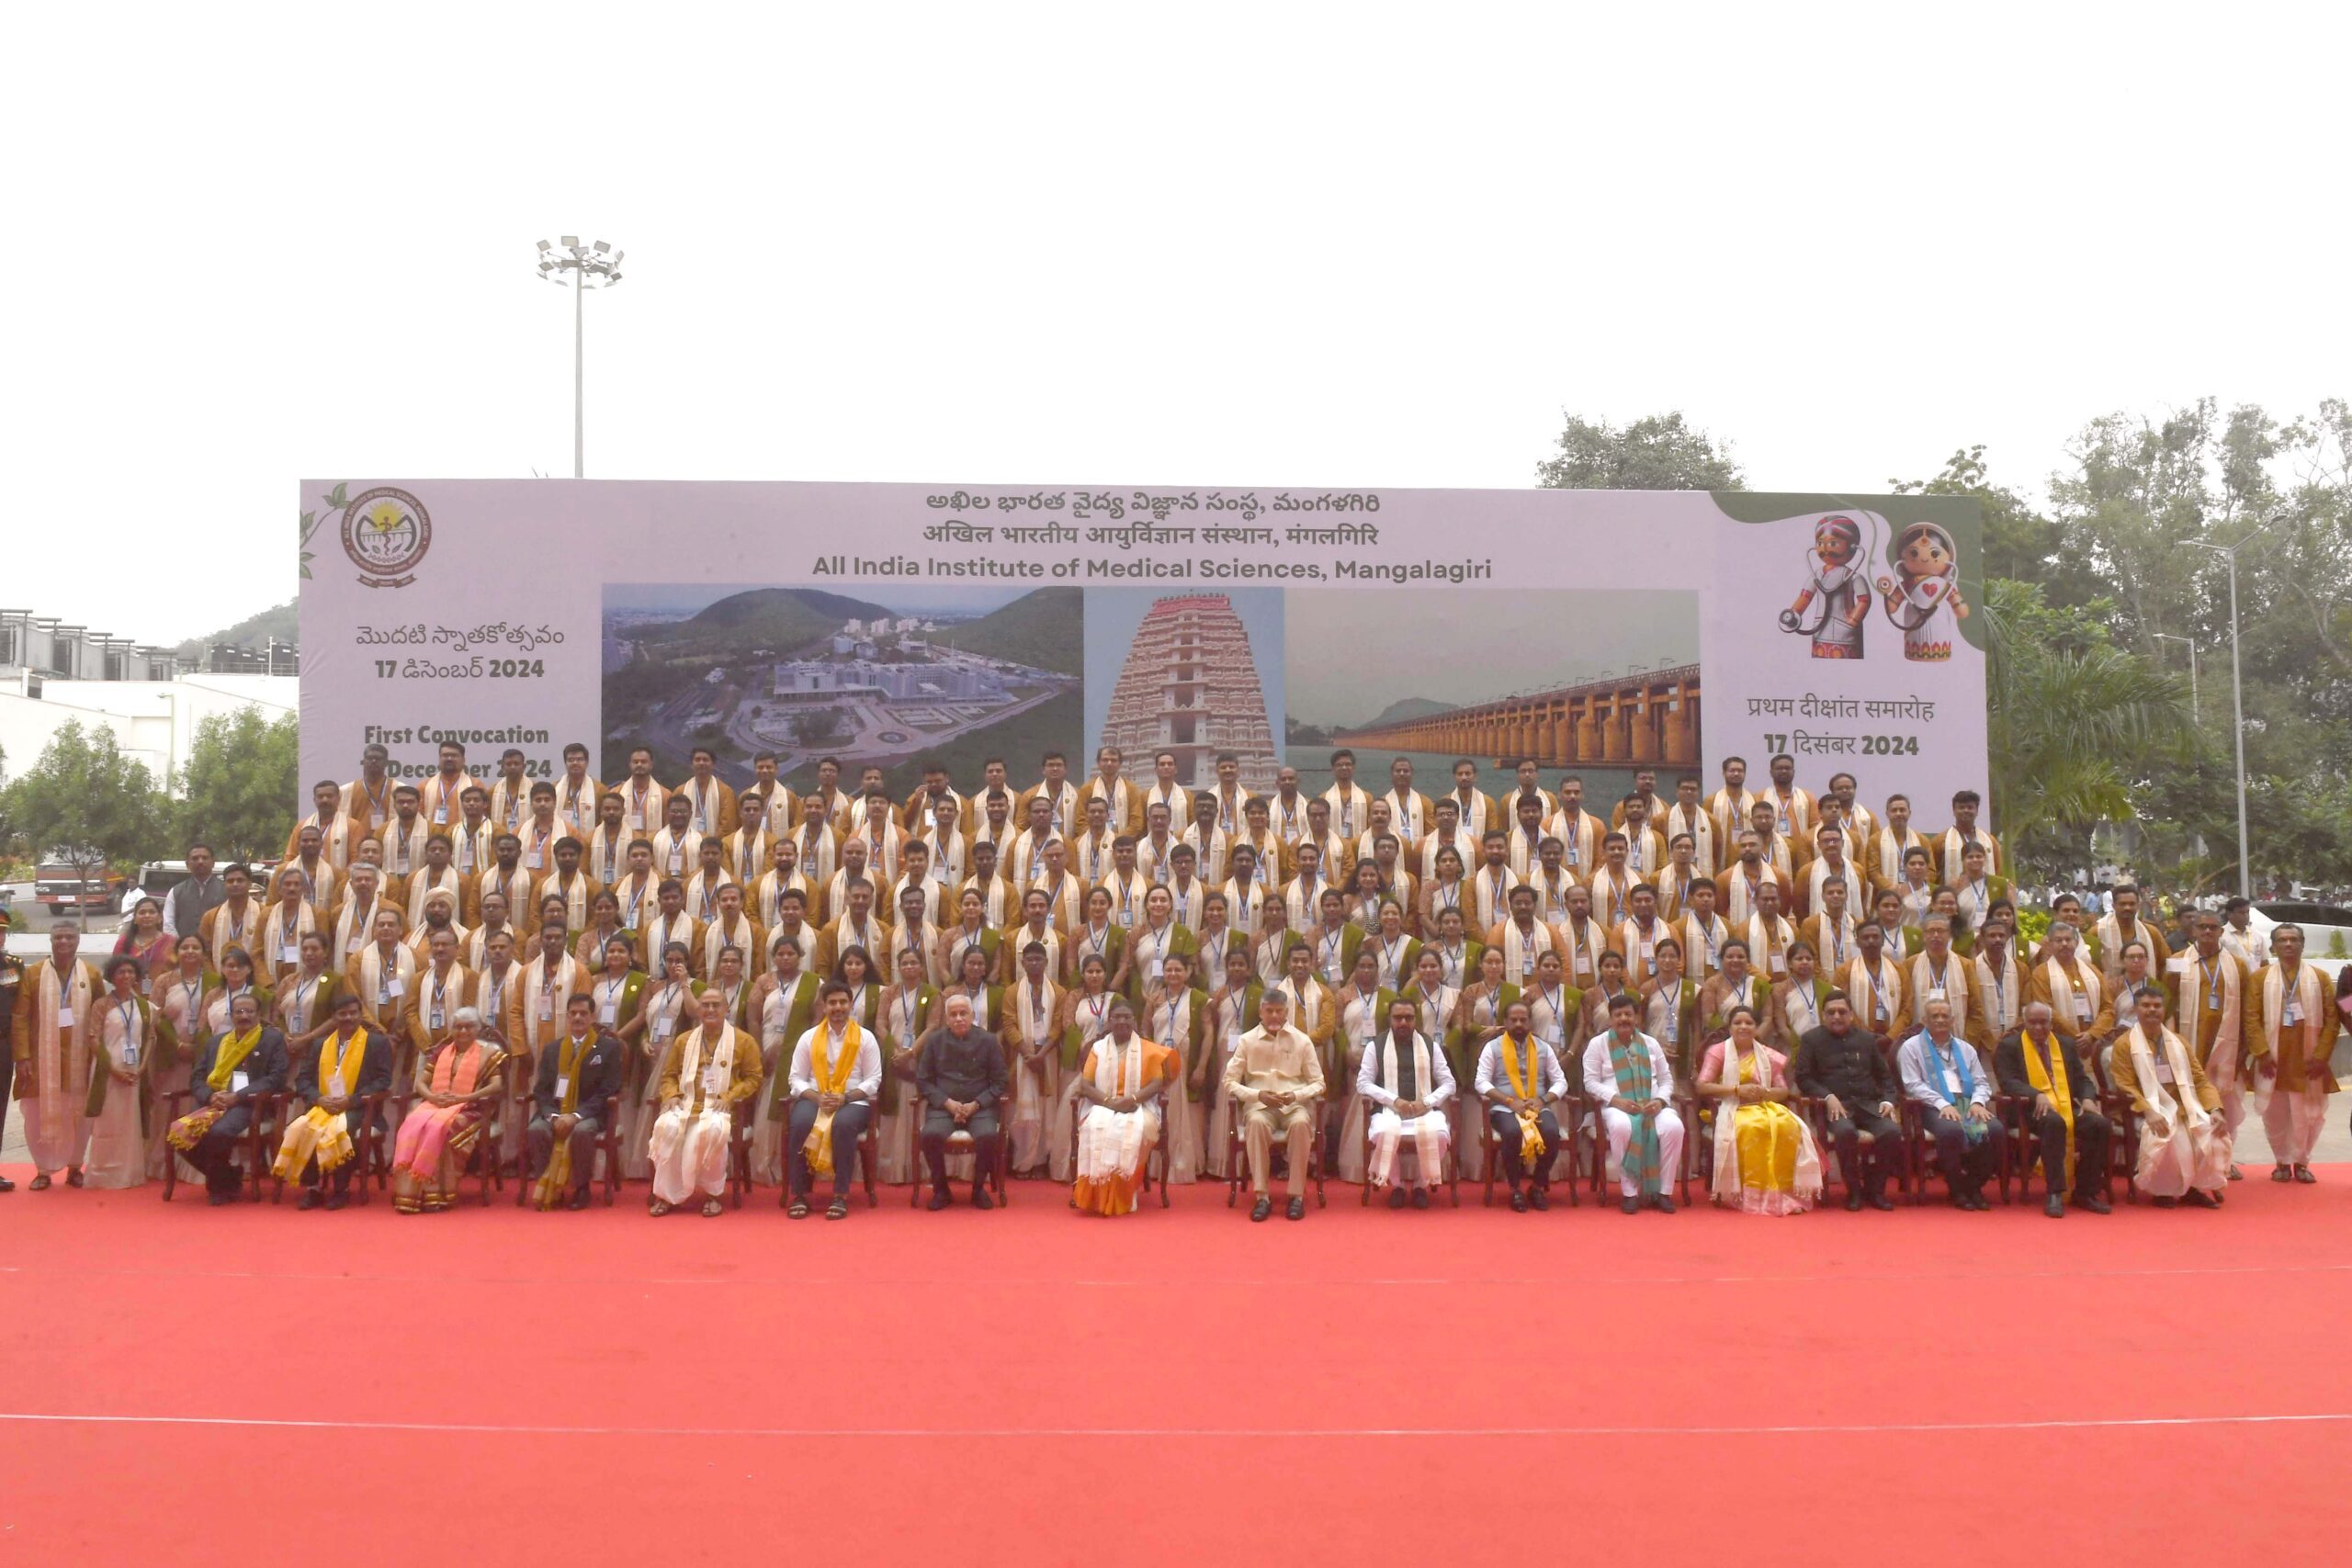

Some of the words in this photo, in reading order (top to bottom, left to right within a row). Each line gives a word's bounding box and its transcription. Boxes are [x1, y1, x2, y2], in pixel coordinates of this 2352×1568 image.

[926, 491, 990, 512] అఖిల
[998, 492, 1066, 513] భారత
[1073, 491, 1125, 519] వైద్య
[1131, 491, 1199, 521] విజ్ఞాన
[1206, 491, 1266, 522] సంస్థ,
[1273, 492, 1381, 513] మంగళగిరి
[923, 520, 995, 543] अखिल
[1001, 521, 1080, 544] भारतीय
[1086, 521, 1196, 550] आयुर्विज्ञान
[1201, 523, 1280, 547] संस्थान,
[1285, 523, 1380, 546] मंगलगिरि
[812, 555, 846, 575] All
[854, 556, 920, 576] India
[928, 556, 1045, 578] Institute
[1051, 558, 1080, 578] of
[1087, 557, 1193, 579] Medical
[1199, 558, 1328, 581] Sciences,
[1335, 558, 1491, 584] Mangalagiri
[356, 624, 427, 645] మొదటి
[432, 621, 565, 652] స్నాతకోత్సవం
[375, 660, 398, 678] 17
[402, 656, 484, 679] డిసెంబర్
[489, 659, 545, 678] 2024
[1747, 698, 1795, 716] प्रथम
[1799, 693, 1860, 718] दीक्षांत
[1864, 694, 1936, 722] समारोह
[364, 725, 413, 744] First
[417, 724, 549, 744] Convocation
[1763, 733, 1788, 754] 17
[1792, 729, 1857, 755] दिसंबर
[1861, 735, 1920, 756] 2024
[387, 760, 492, 779] Deceer
[496, 759, 553, 779] 224
